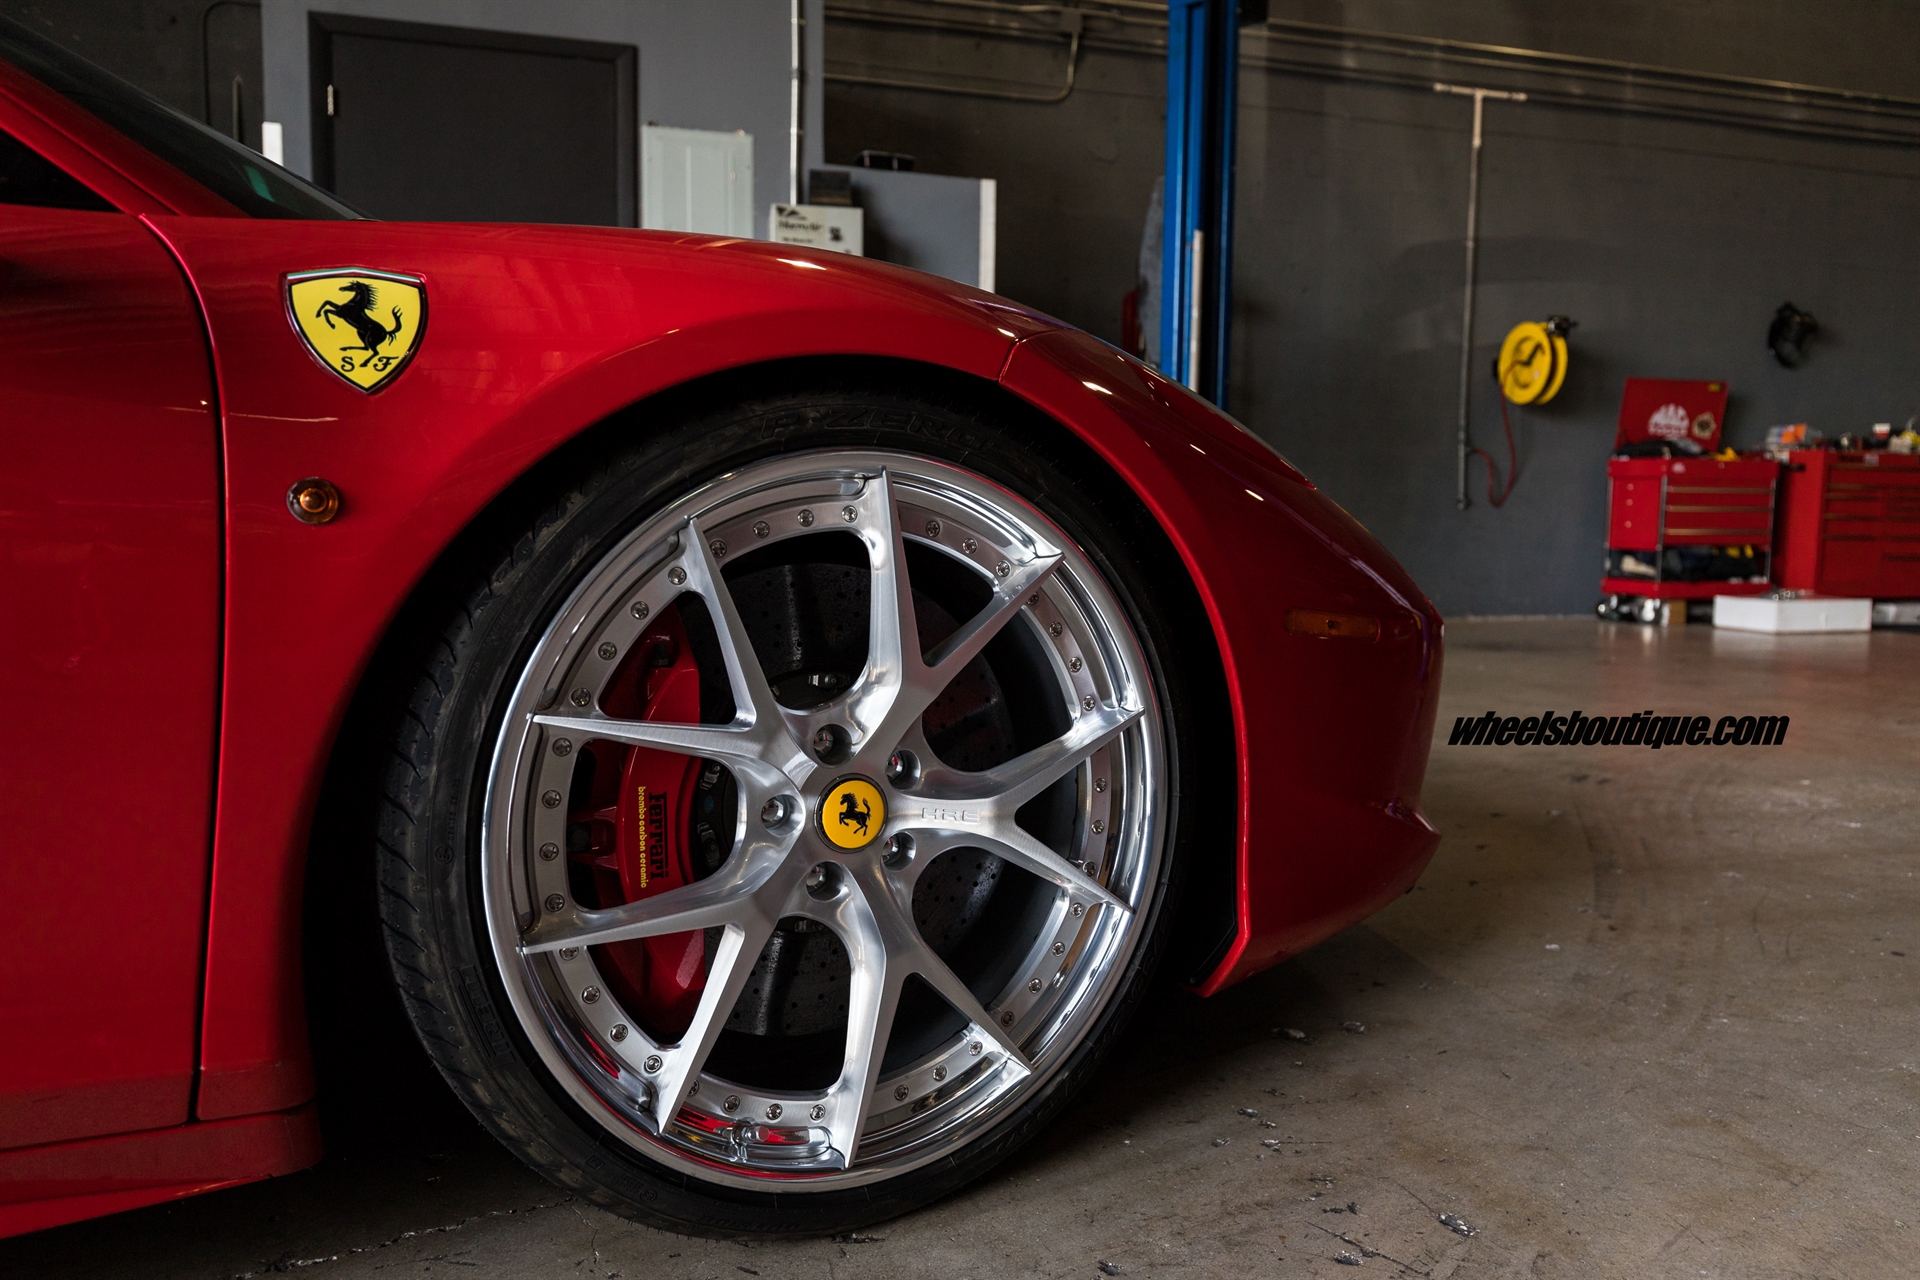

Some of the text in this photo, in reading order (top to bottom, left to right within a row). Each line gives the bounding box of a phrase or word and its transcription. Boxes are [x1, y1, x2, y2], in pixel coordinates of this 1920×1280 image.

[760, 403, 988, 451] P ZERO
[638, 786, 649, 888] brembo carbon ceramic
[648, 791, 669, 880] Ferrari
[922, 807, 980, 824] HRE
[451, 965, 516, 1068] PIRELLI
